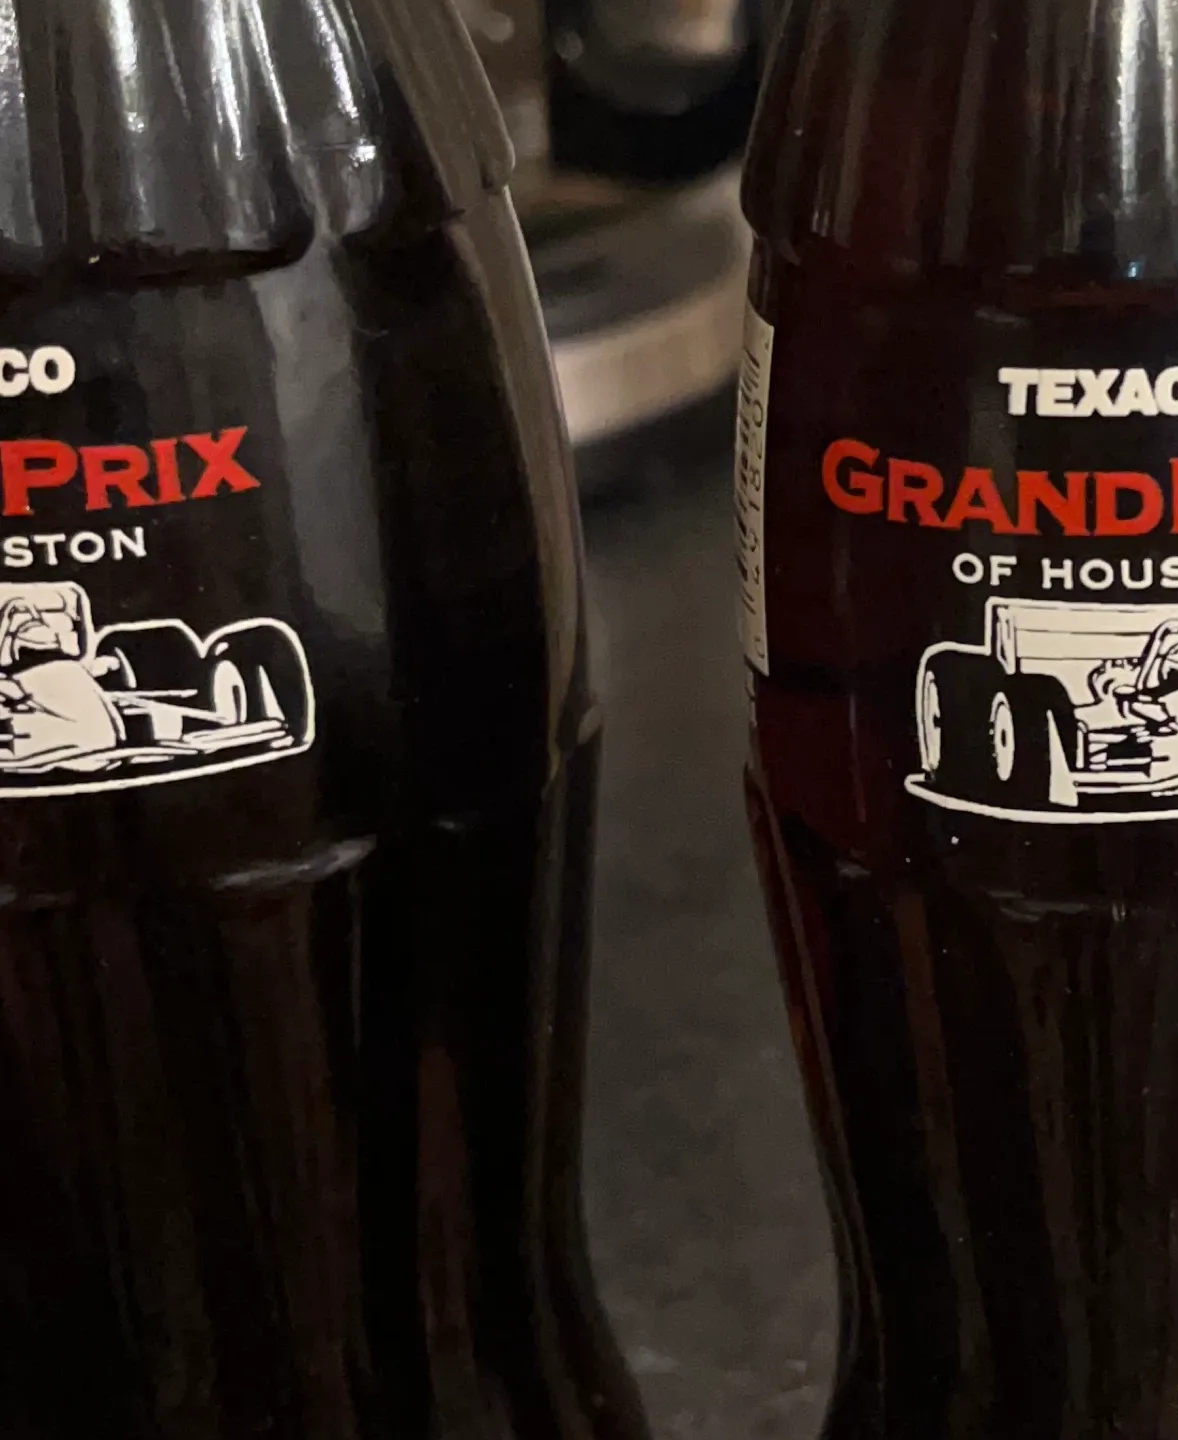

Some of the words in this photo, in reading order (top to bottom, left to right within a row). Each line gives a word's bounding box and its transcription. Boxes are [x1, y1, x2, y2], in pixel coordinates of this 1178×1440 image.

[0, 426, 261, 517] PRIX
[3, 526, 148, 568] STON
[952, 552, 1017, 586] OF
